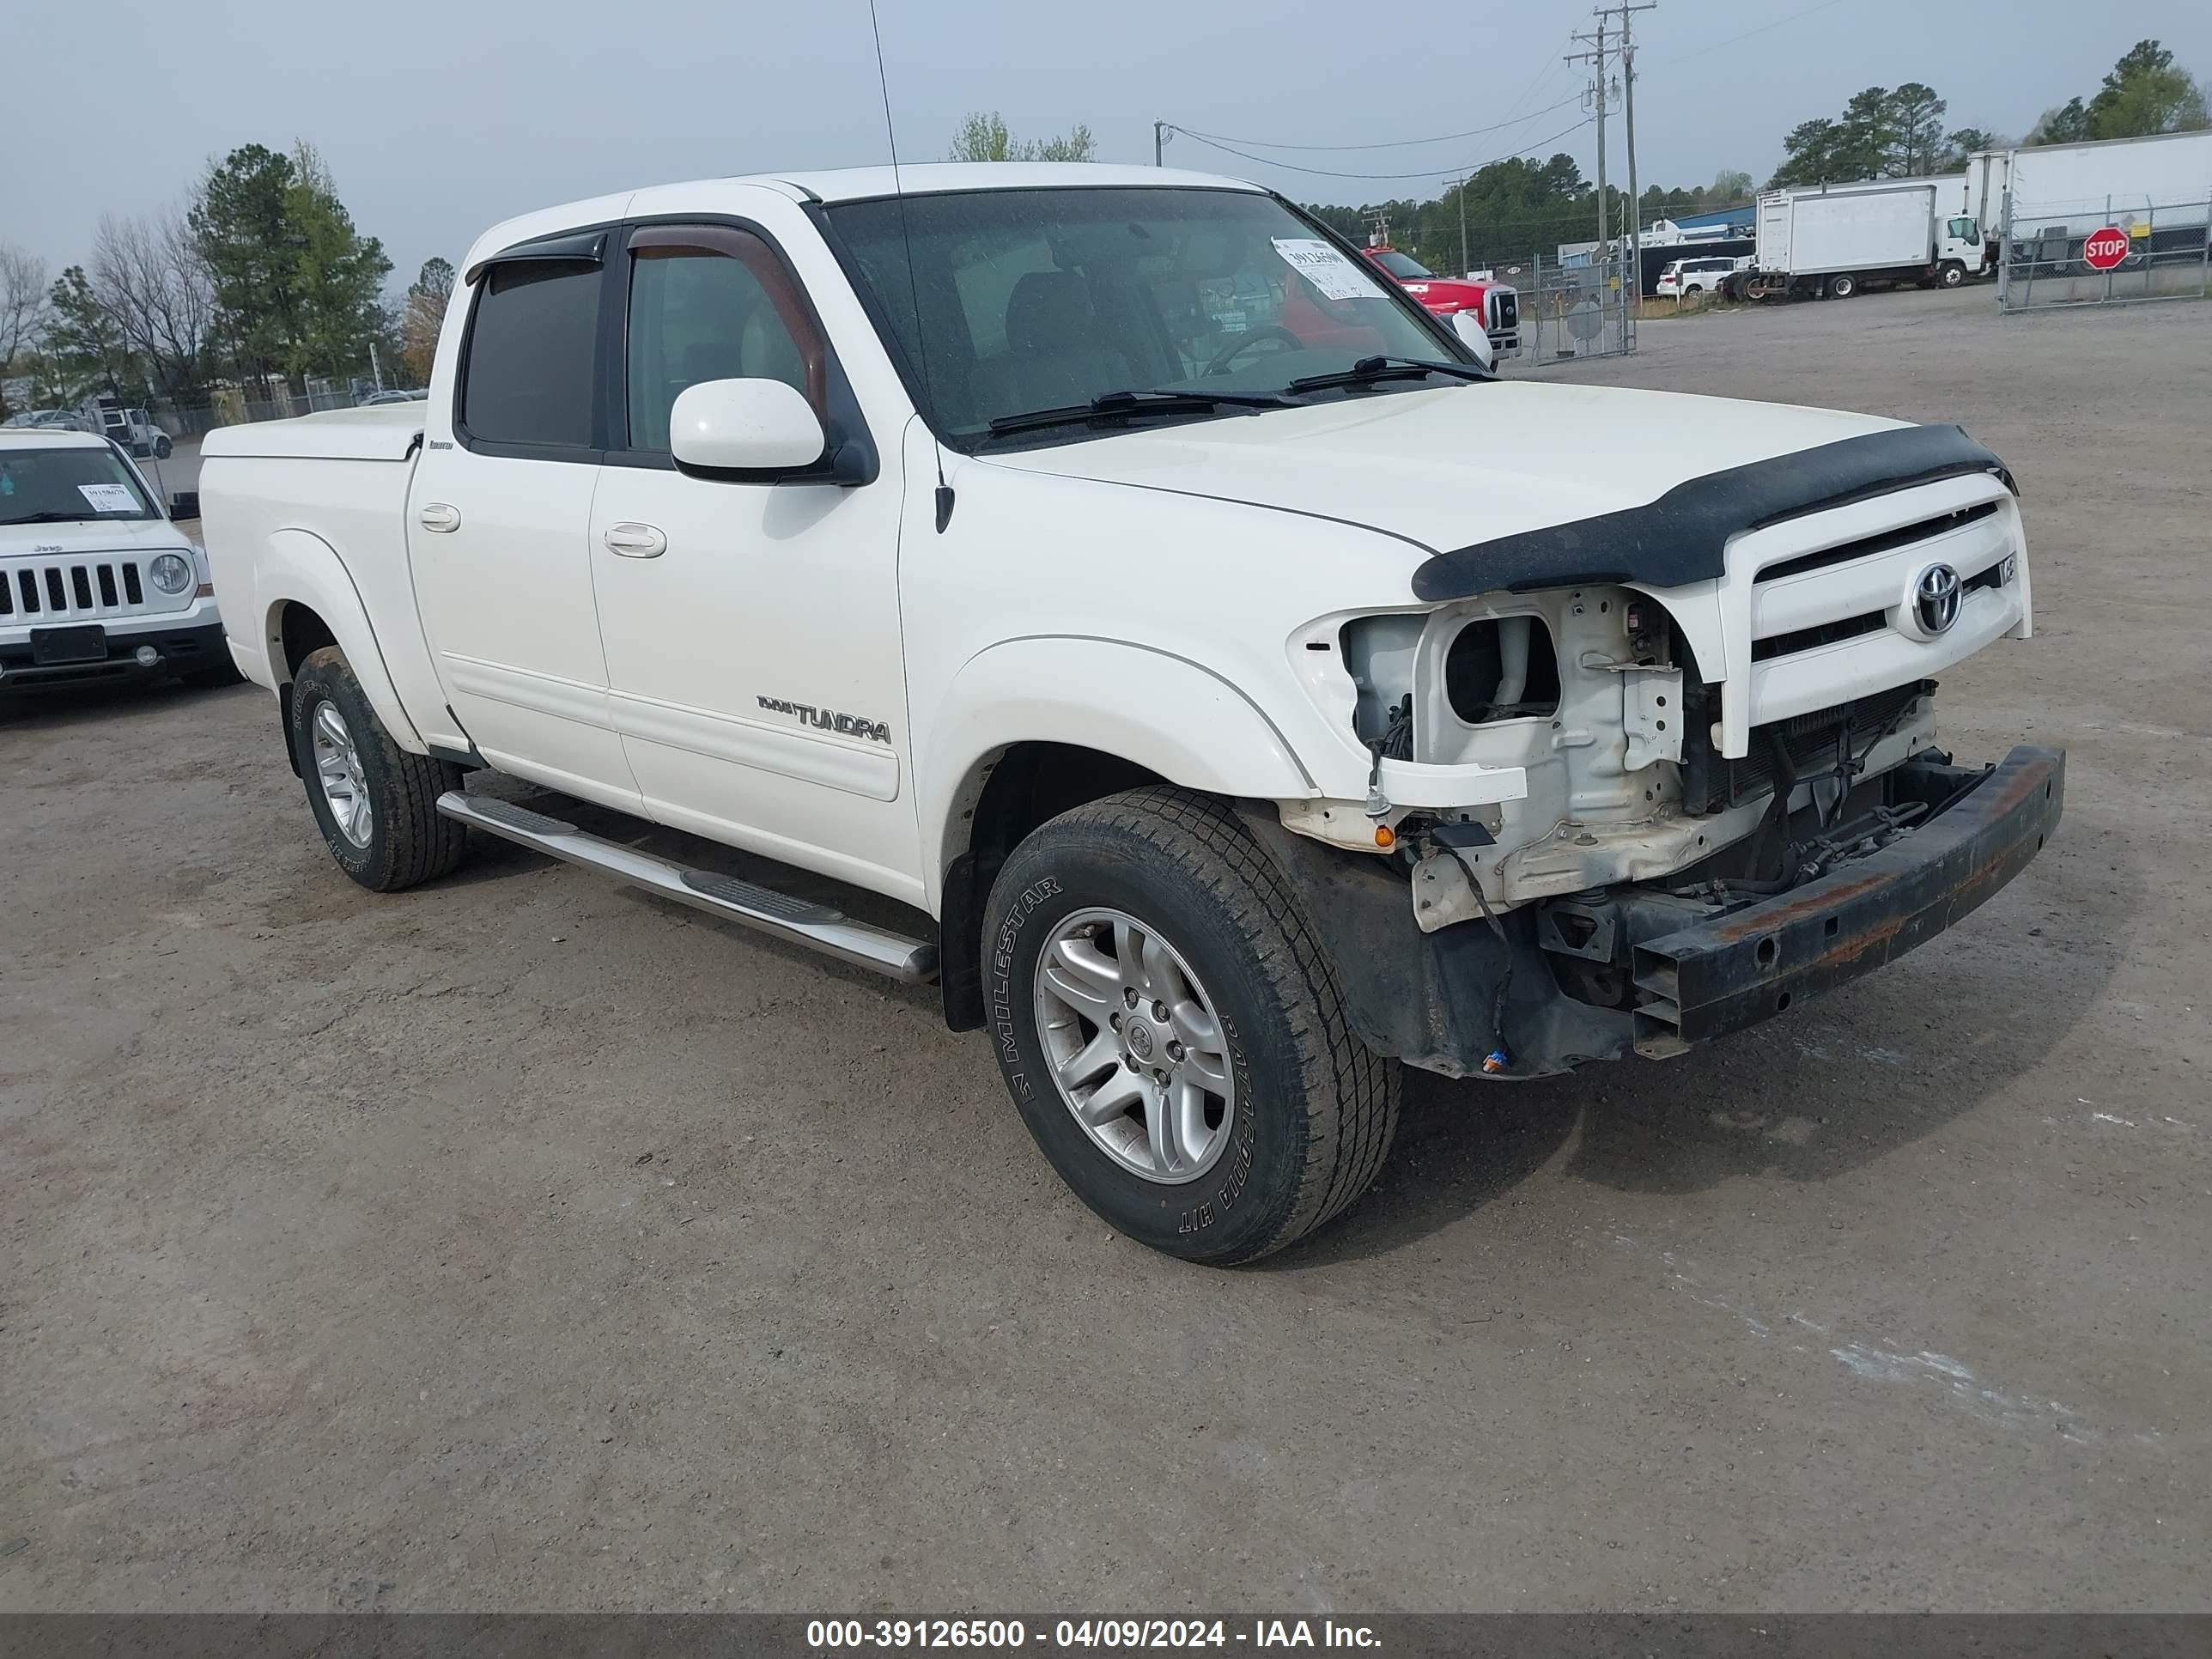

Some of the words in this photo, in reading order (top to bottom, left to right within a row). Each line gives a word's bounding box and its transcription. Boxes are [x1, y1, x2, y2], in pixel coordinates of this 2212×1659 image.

[2087, 240, 2125, 257] STOP
[794, 703, 891, 744] TUNDRA
[994, 877, 1065, 1064] MILESTAR
[1218, 1015, 1255, 1210] PATAGONIA
